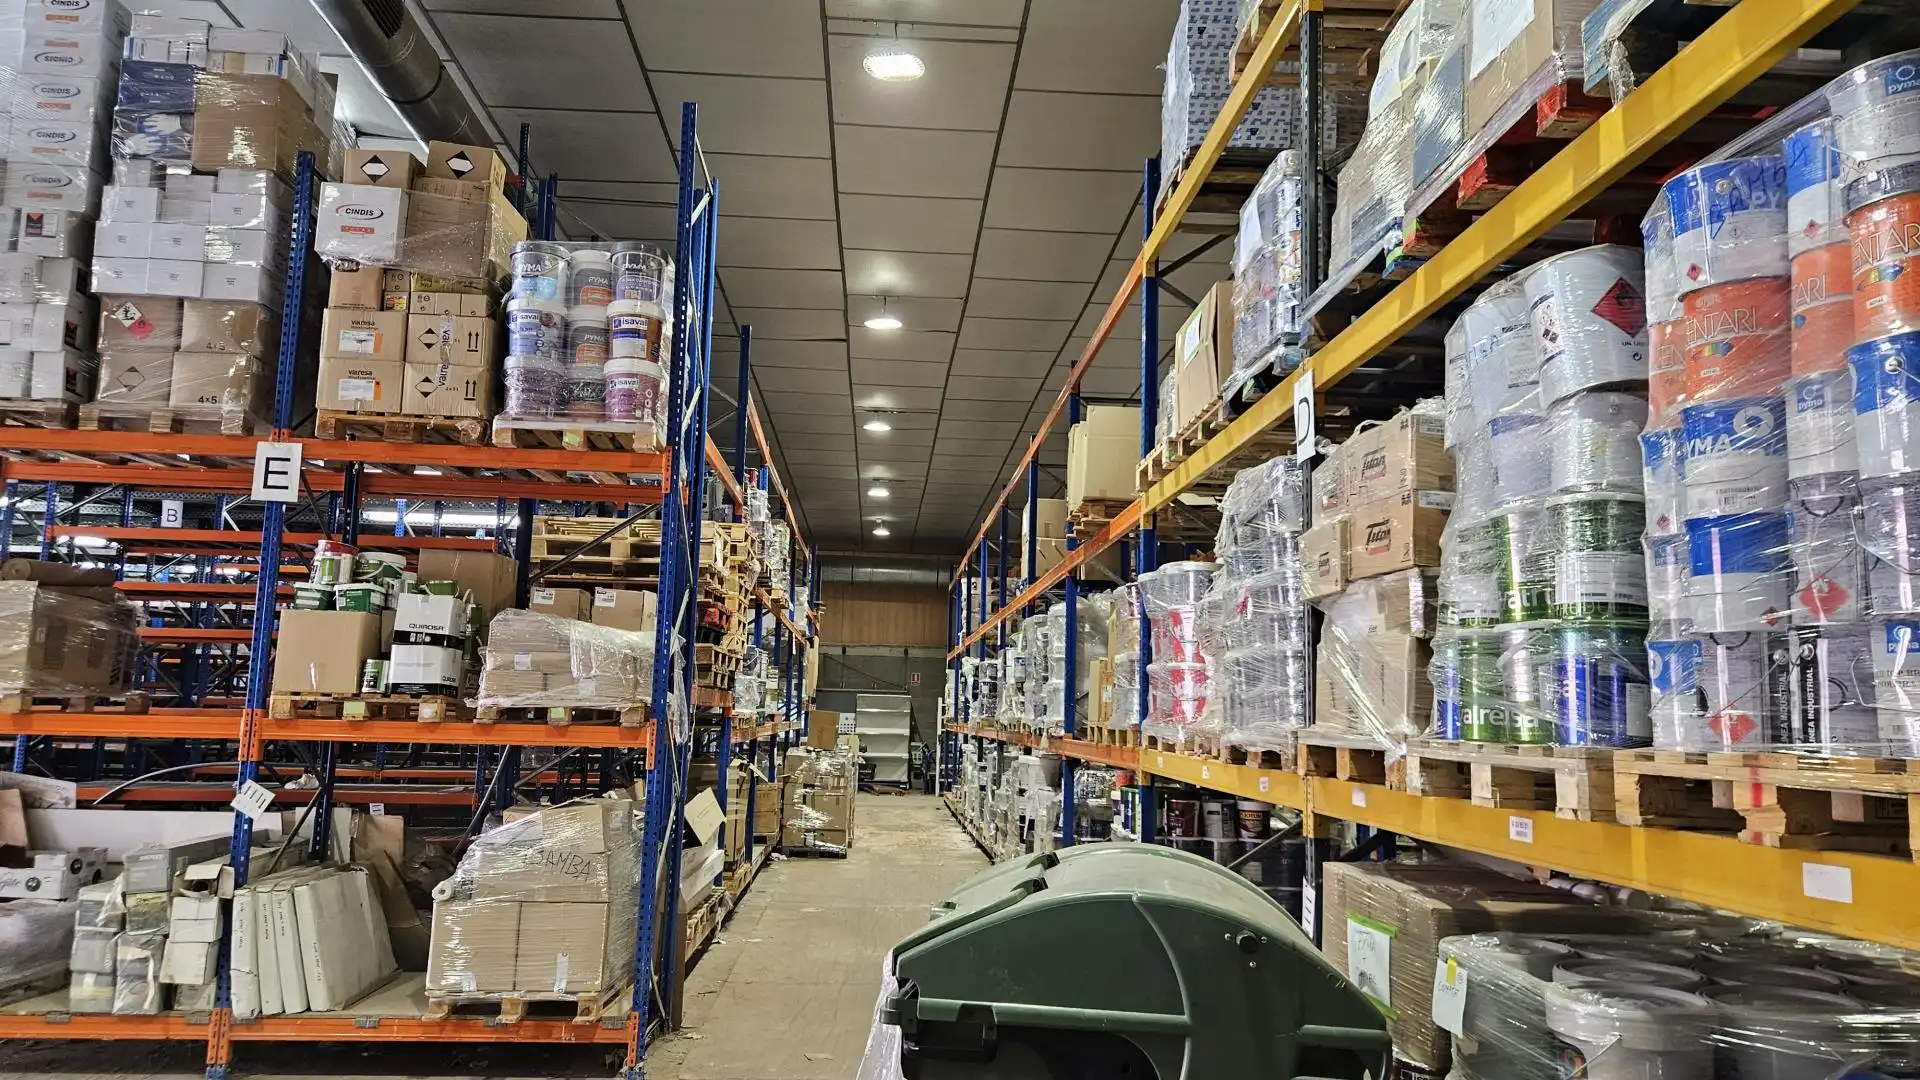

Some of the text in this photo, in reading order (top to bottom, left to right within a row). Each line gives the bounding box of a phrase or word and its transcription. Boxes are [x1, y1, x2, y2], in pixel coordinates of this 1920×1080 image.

[41, 87, 71, 95] CINDIS
[36, 131, 66, 139] CINDIS
[345, 208, 374, 216] CINDIS
[622, 317, 648, 327] isaval
[262, 456, 291, 490] E
[166, 508, 178, 523] B
[408, 623, 445, 631] QUIROSA
[1806, 666, 1814, 720] INDUSTRIAL
